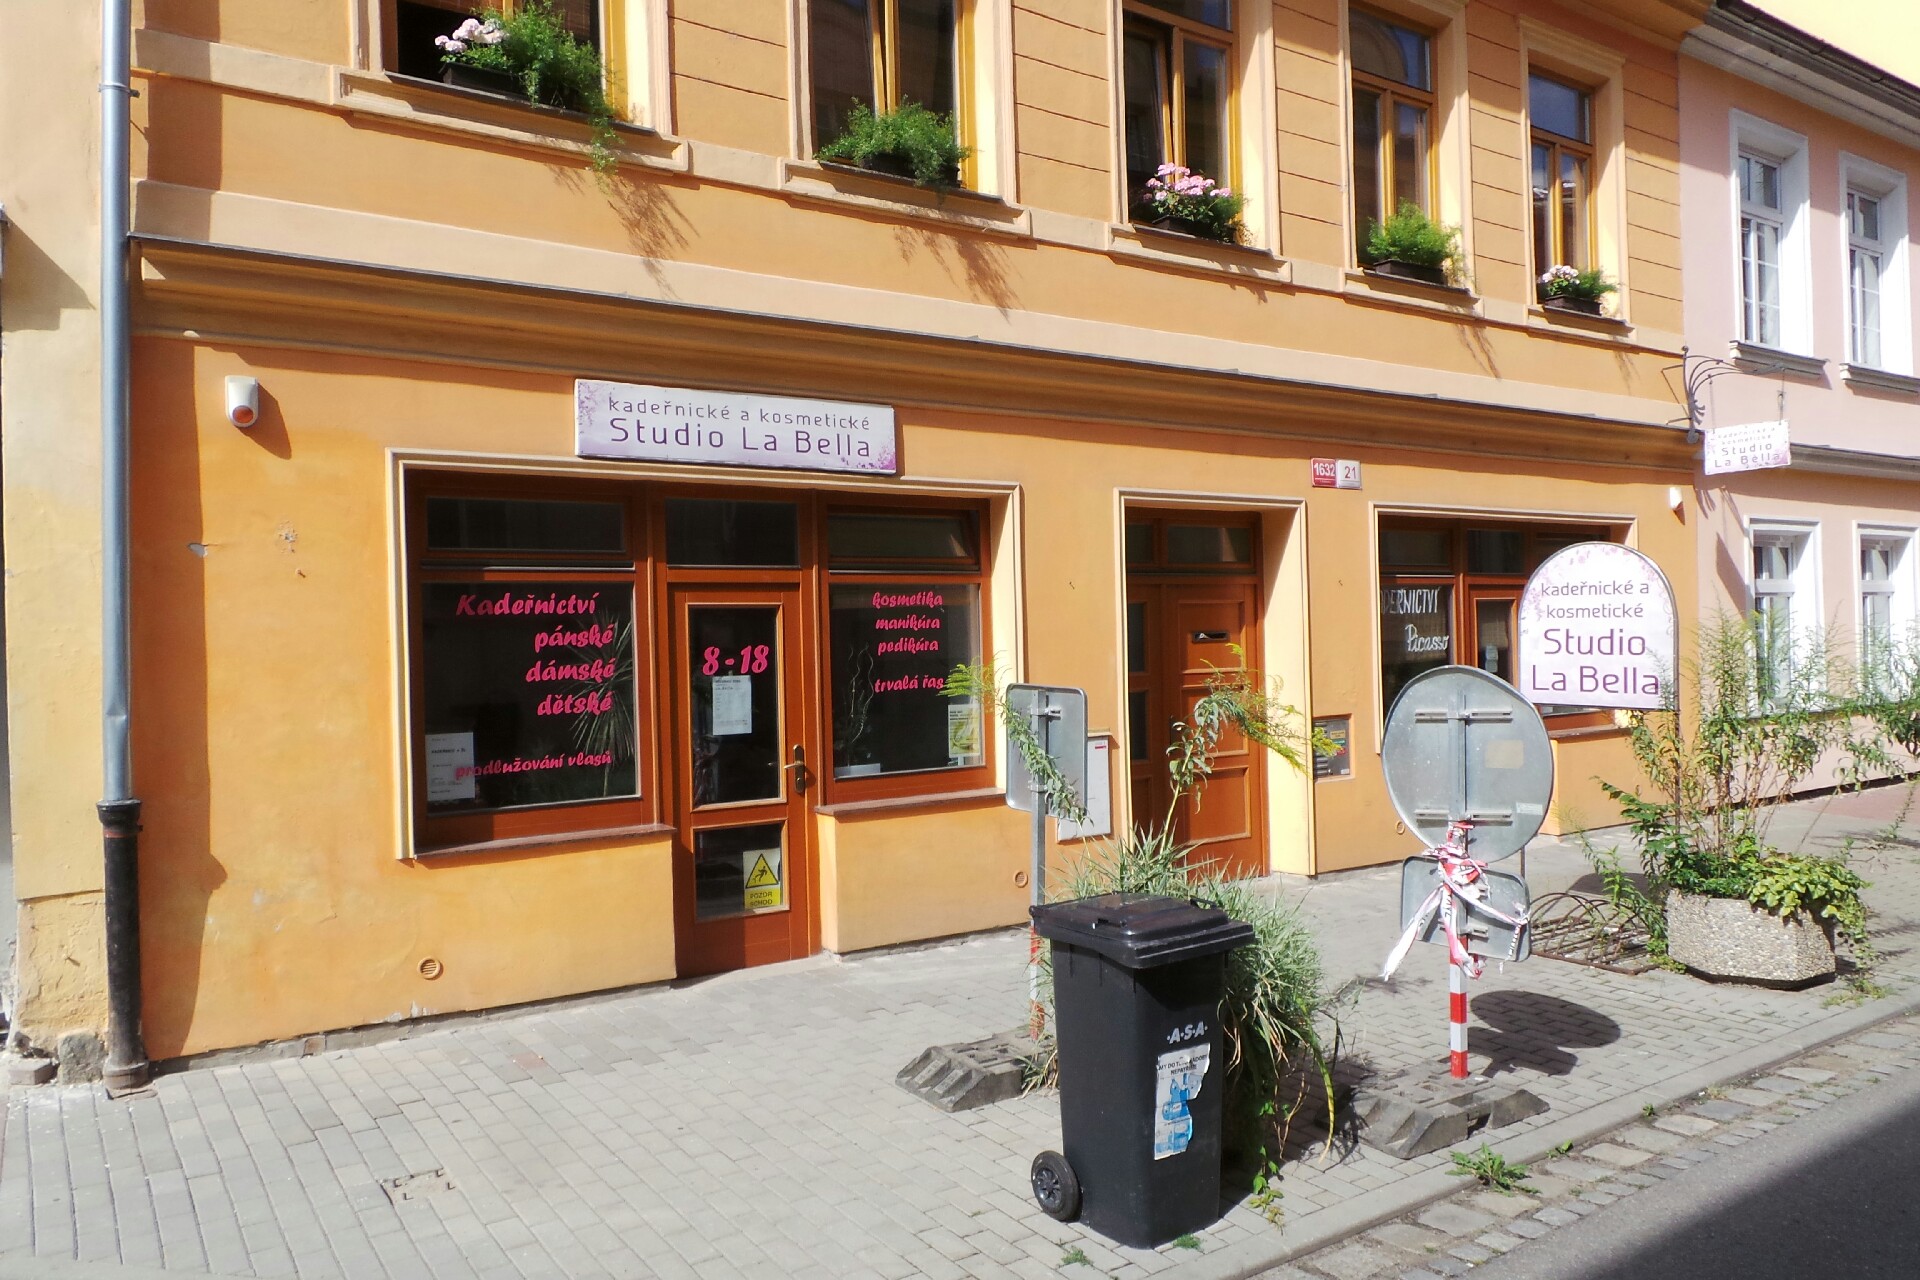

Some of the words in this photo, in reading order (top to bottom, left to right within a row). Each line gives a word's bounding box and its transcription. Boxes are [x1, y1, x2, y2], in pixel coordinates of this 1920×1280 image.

[608, 396, 731, 421] kadeřnické
[740, 408, 750, 422] a
[760, 408, 871, 431] kosmetické
[611, 417, 724, 448] Studio
[742, 426, 778, 452] La
[795, 430, 871, 457] Bella
[1714, 459, 1731, 468] La
[1740, 453, 1780, 465] Bella
[1721, 443, 1772, 456] Studio
[1313, 462, 1336, 477] 1632
[1344, 465, 1357, 480] 21
[1540, 580, 1634, 597] kadeřnické
[1639, 582, 1650, 595] a
[456, 591, 600, 616] Kadeřnictví
[872, 591, 943, 610] kosmetika
[1546, 602, 1644, 619] kosmetické
[875, 614, 941, 631] manikúra
[534, 623, 615, 653] pánské
[877, 637, 939, 656] pedikúra
[1404, 623, 1450, 653] Picasso
[1543, 627, 1646, 656] Studio
[525, 657, 616, 683] dámské
[1532, 664, 1567, 692] La
[1578, 665, 1661, 696] Bella
[874, 674, 919, 694] trvalá
[922, 674, 944, 690] řas
[536, 690, 614, 716] dětské
[454, 753, 565, 781] prodlužování
[567, 750, 613, 767] vlasů
